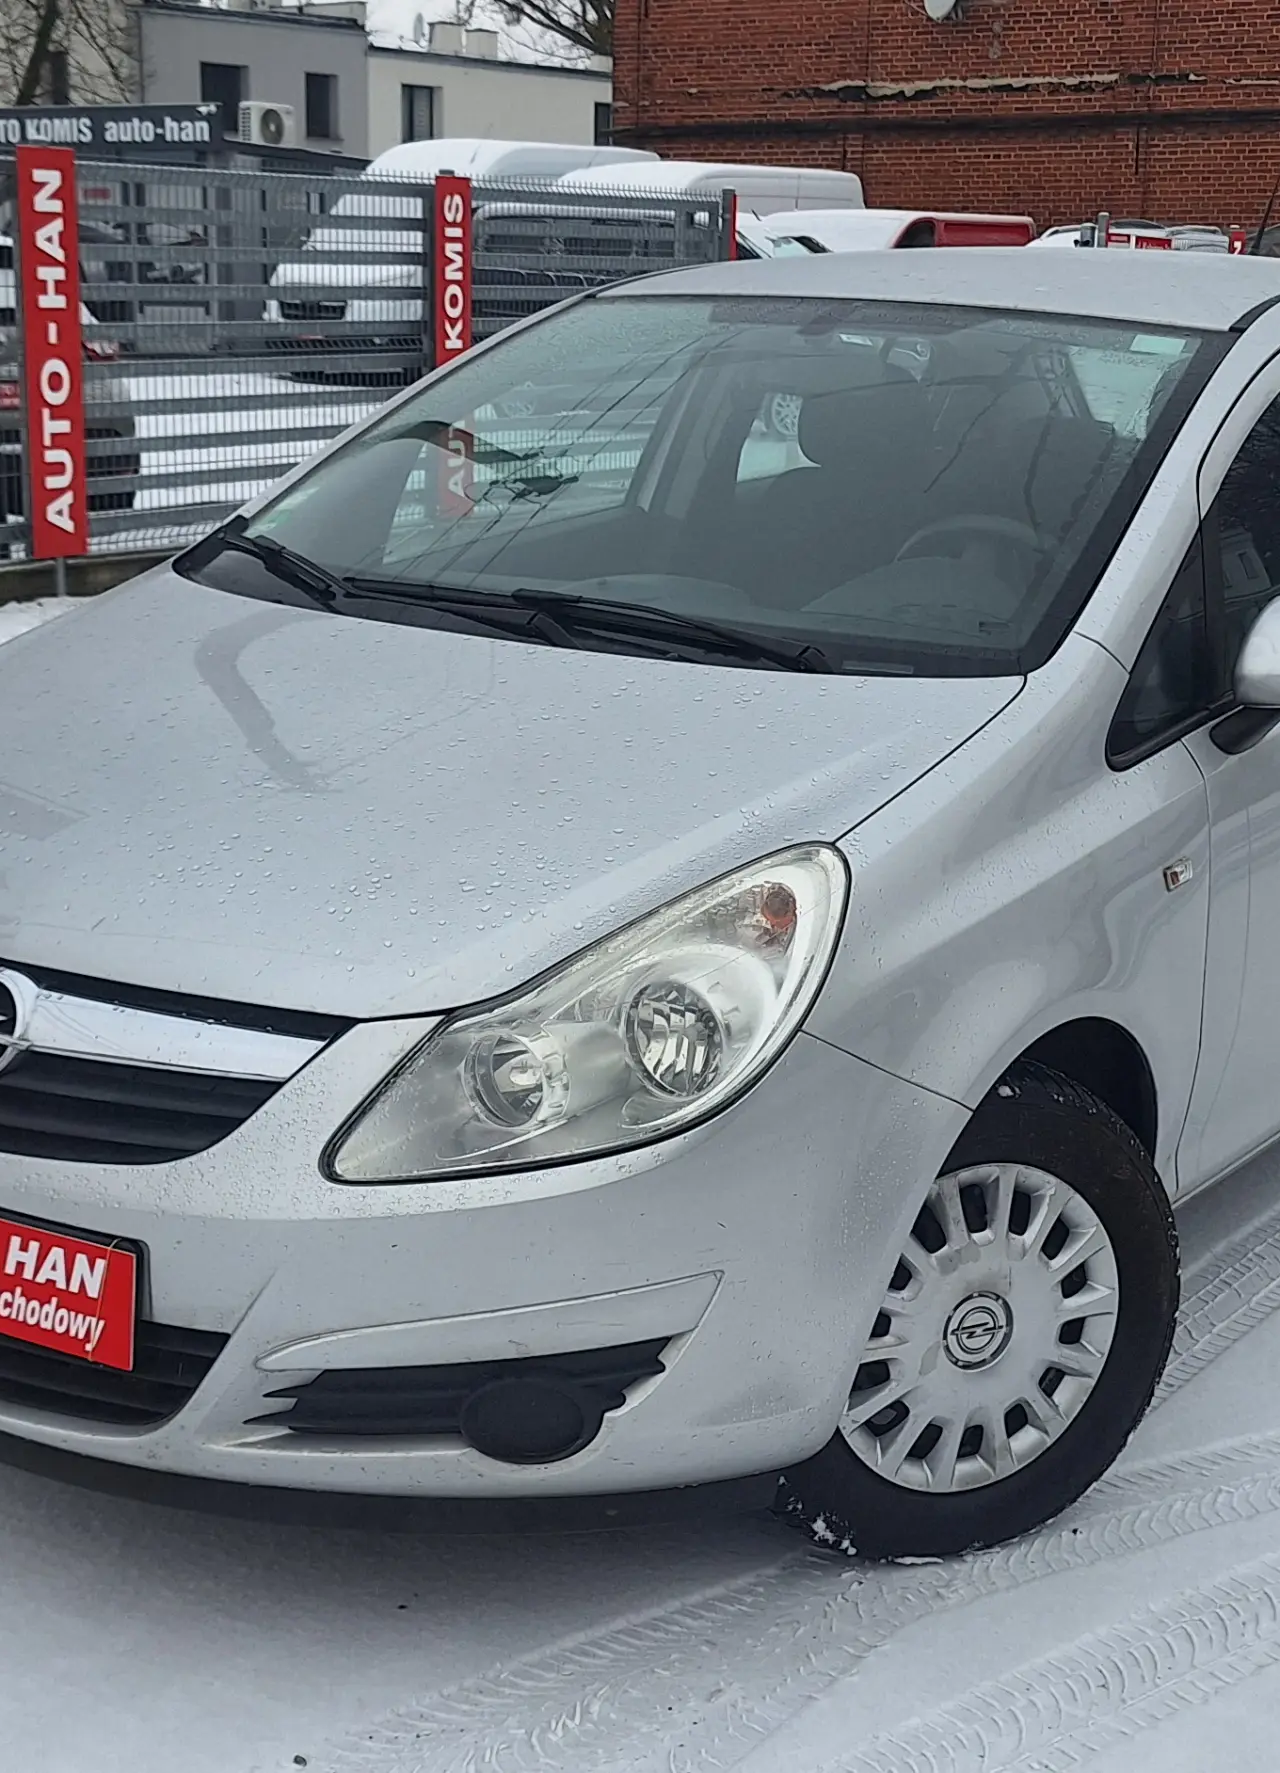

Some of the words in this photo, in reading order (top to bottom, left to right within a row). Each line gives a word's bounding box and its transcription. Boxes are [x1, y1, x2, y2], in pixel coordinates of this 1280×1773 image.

[24, 116, 93, 143] KOMIS
[104, 116, 210, 143] auto-han
[443, 193, 465, 350] KOMIS
[3, 1235, 108, 1300] HAN
